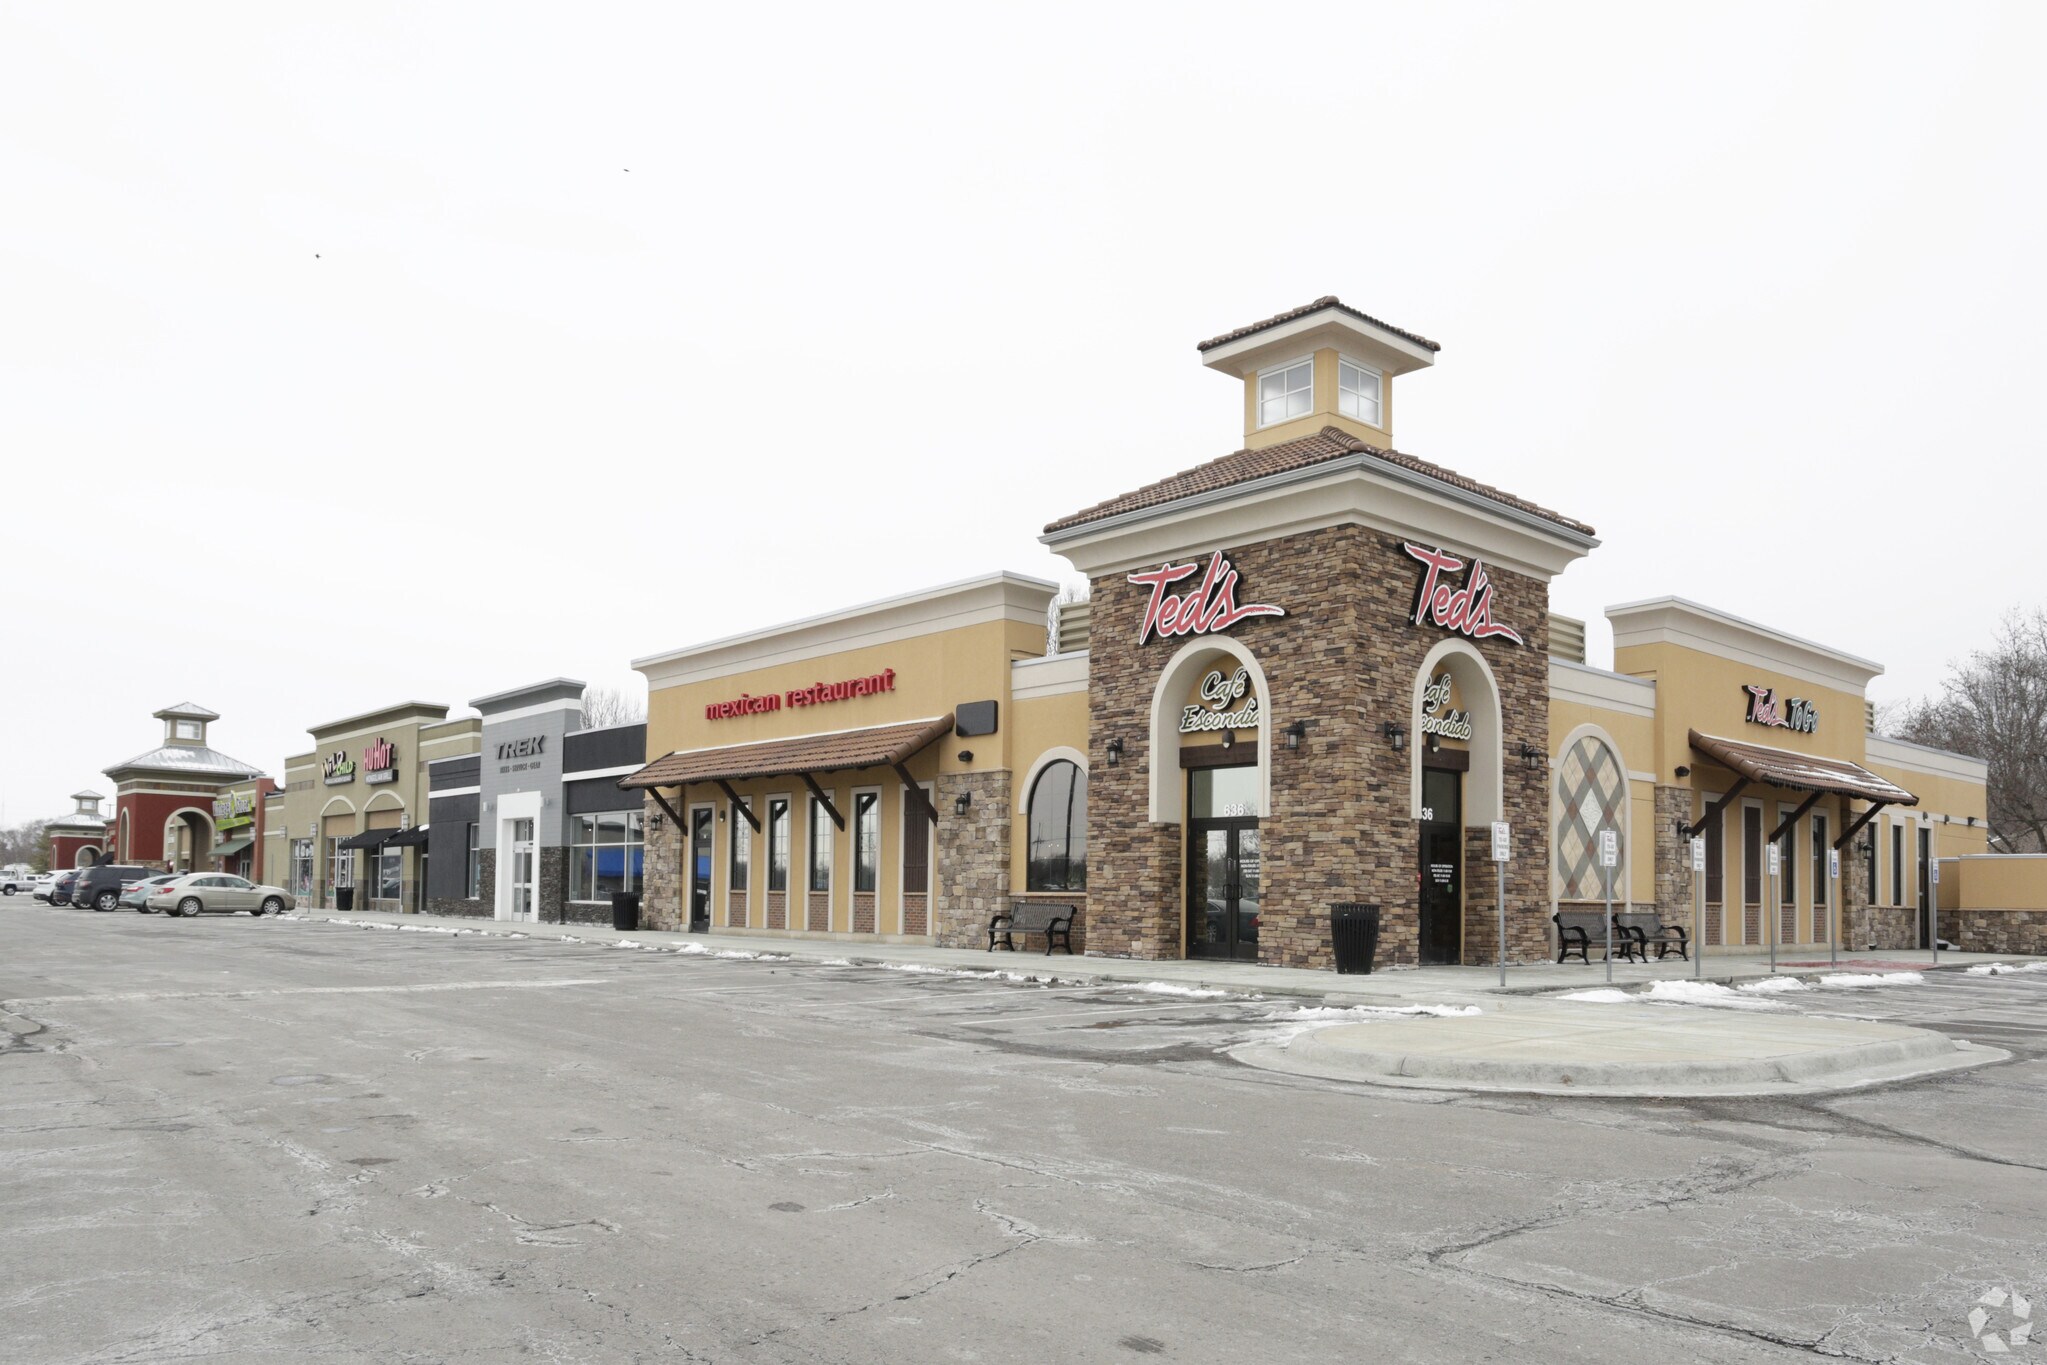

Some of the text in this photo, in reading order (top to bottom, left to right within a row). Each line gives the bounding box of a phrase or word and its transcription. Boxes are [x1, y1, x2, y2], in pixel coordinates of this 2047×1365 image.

[1127, 550, 1285, 645] Ted's
[1404, 541, 1524, 645] Ted's
[705, 668, 897, 720] mexican restaurant
[1201, 665, 1247, 710] Café
[1179, 697, 1259, 732] Escondi
[1422, 708, 1472, 740] condido
[1744, 685, 1789, 728] Ted's
[495, 734, 545, 760] TREK
[336, 760, 354, 776] CHILD
[1224, 804, 1245, 817] 636
[1422, 807, 1433, 820] 36
